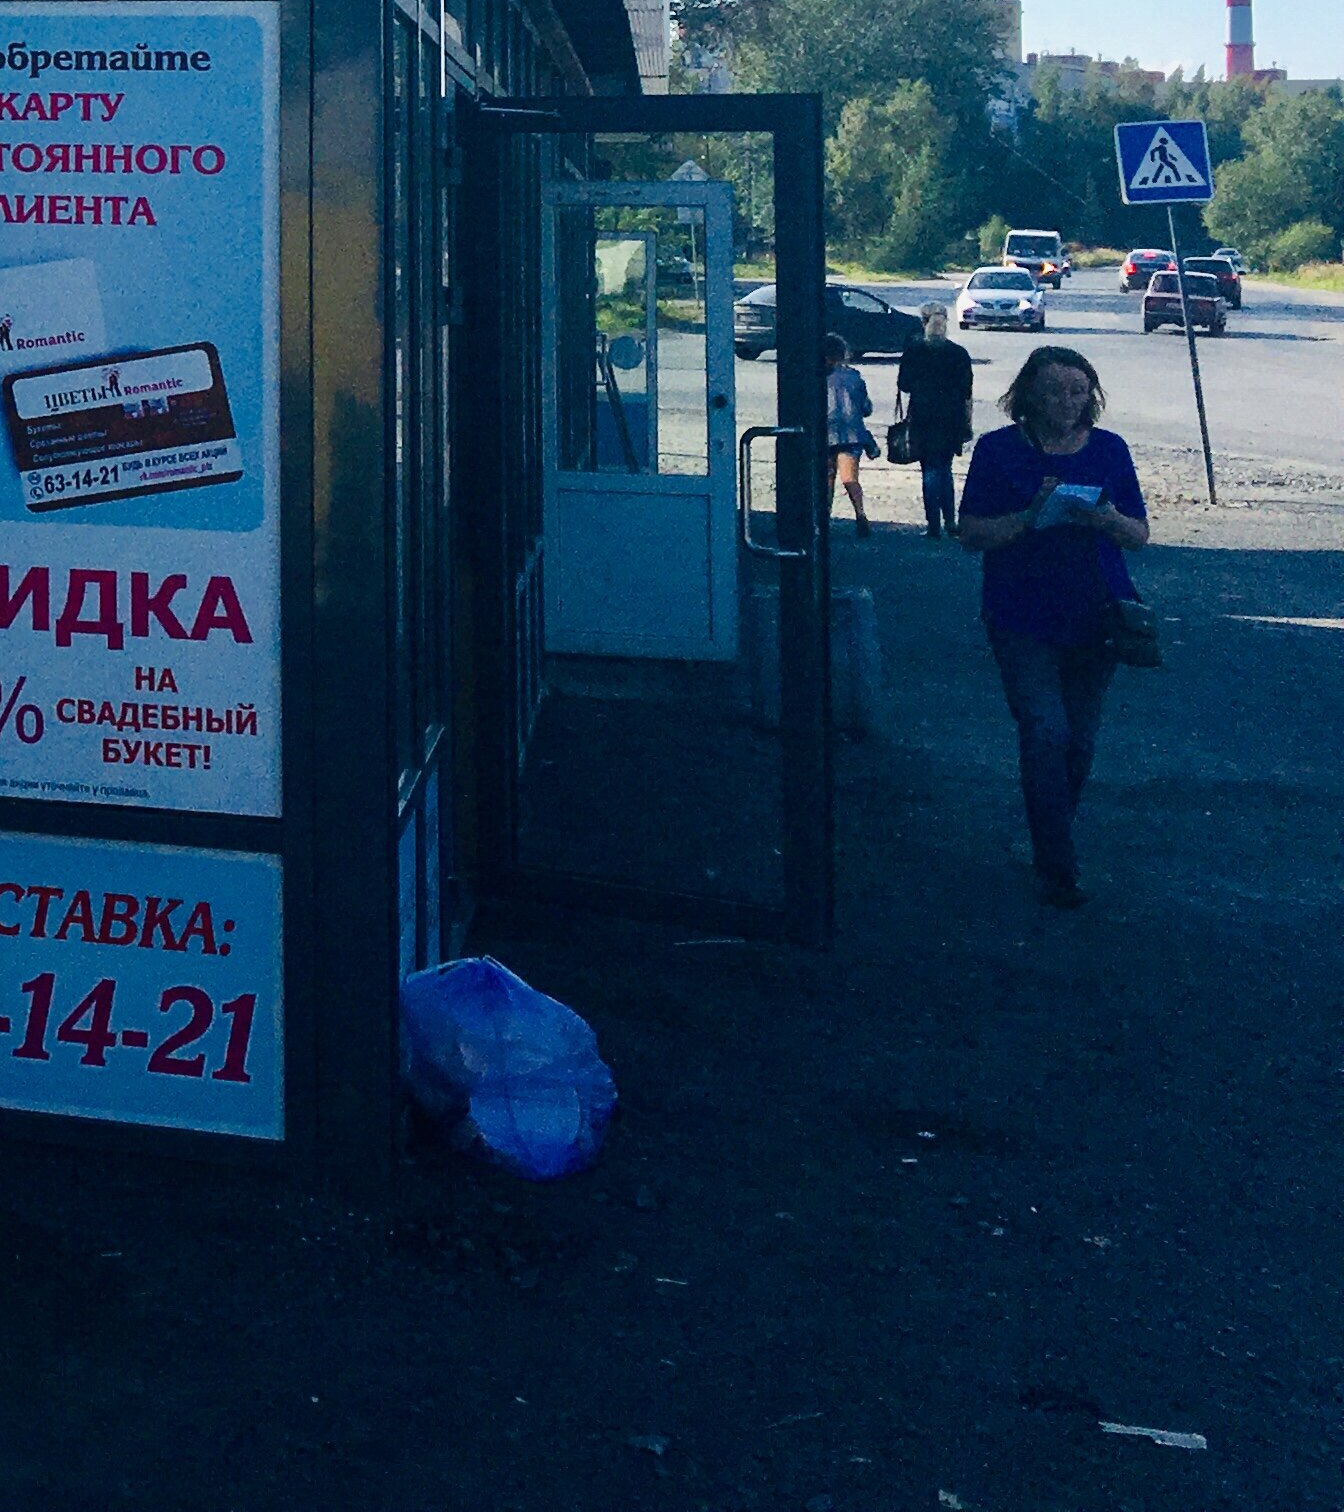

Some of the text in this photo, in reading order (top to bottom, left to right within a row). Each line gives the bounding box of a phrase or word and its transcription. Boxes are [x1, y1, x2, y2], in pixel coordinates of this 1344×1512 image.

[16, 330, 86, 350] Romantic
[123, 377, 184, 397] Romantic
[44, 464, 120, 495] 63-14-21
[134, 665, 179, 695] НА
[55, 697, 258, 737] СВАДЕБНЫЙ
[101, 737, 212, 771] БУКЕТ!
